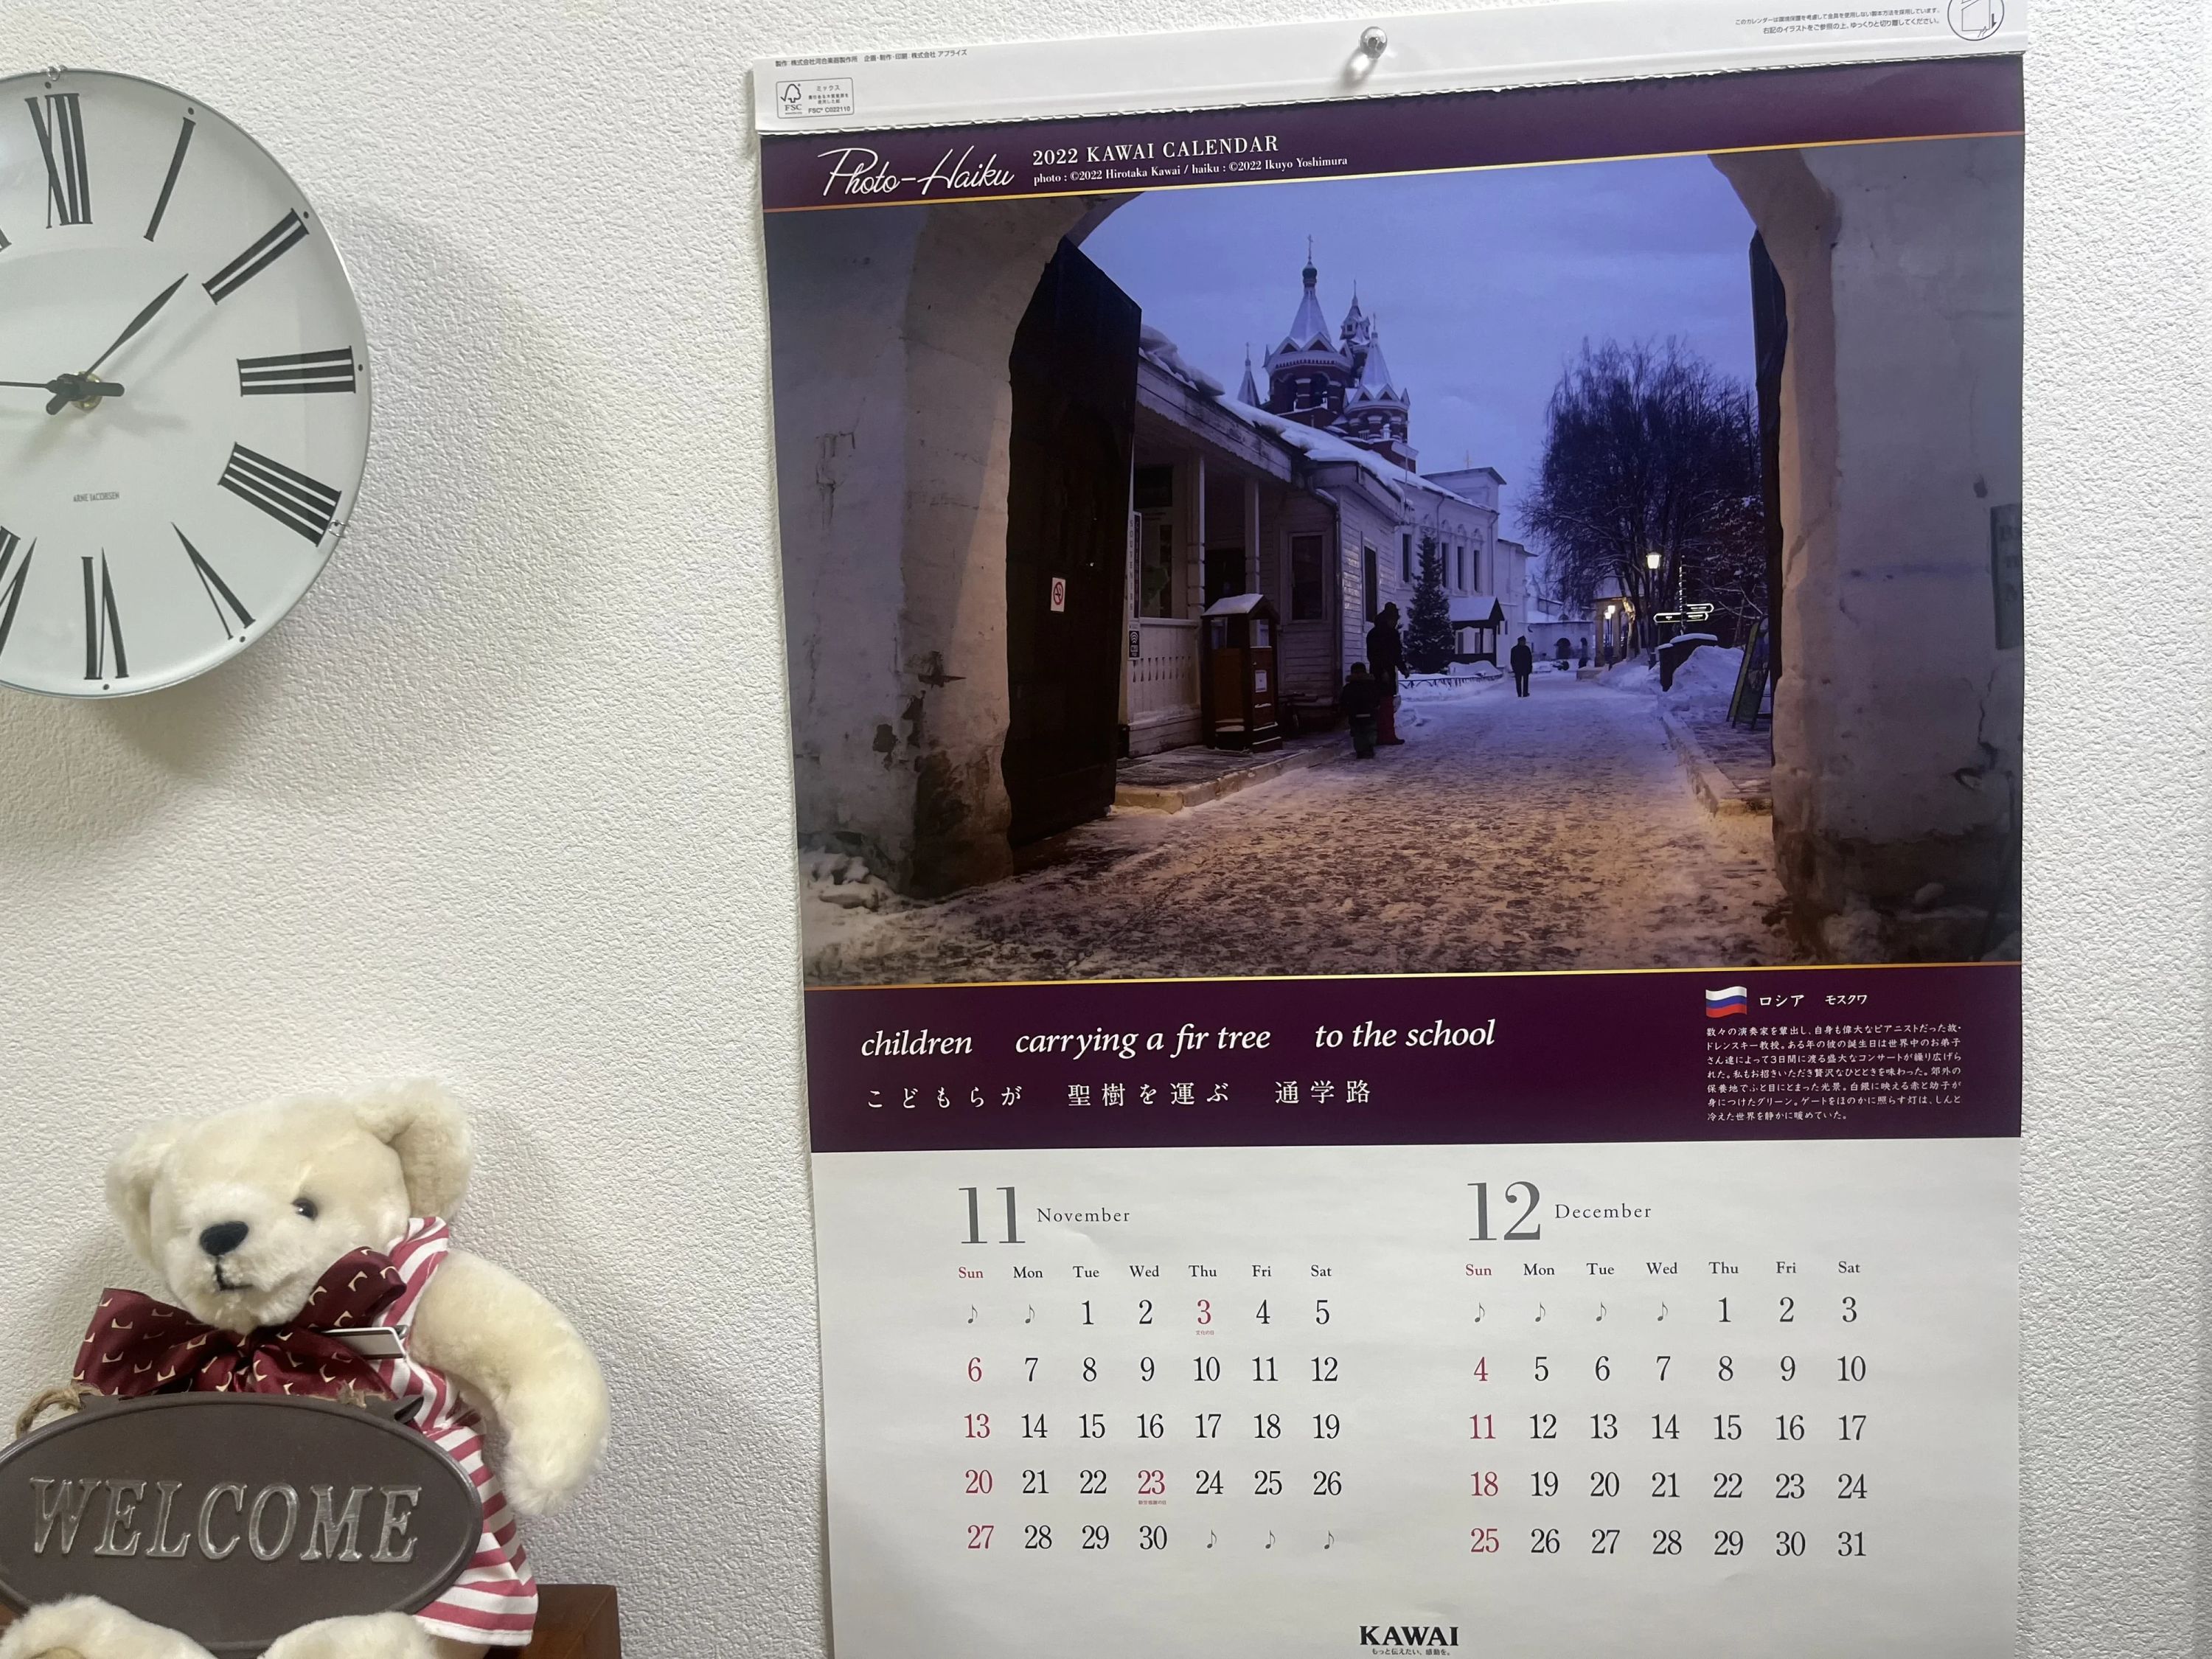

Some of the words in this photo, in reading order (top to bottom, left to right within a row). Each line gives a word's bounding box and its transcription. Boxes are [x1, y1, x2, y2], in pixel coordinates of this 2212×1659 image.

[26, 92, 94, 229] XII
[1032, 147, 1078, 166] 2022
[1087, 143, 1155, 162] KAWAI
[1163, 134, 1279, 158] CALENDAR
[1034, 173, 1062, 187] photo
[1071, 170, 1102, 181] ©2022
[1105, 167, 1149, 180] Hirotaka
[1151, 166, 1180, 176] Kawai
[1192, 163, 1220, 174] haiku
[1230, 160, 1262, 172] ©2022
[1265, 159, 1293, 170] Ikuyo
[1296, 155, 1348, 168] Yoshimura
[201, 207, 309, 305] II
[237, 346, 356, 396] III
[218, 442, 342, 547] IIII
[1759, 994, 1804, 1007] ロシア
[1825, 995, 1868, 1005] モスクワ
[861, 1029, 973, 1057] children
[1015, 1027, 1139, 1060] carrying
[1146, 1032, 1164, 1051] a
[1169, 1023, 1210, 1059] fir
[1217, 1026, 1271, 1049] tree
[1315, 1025, 1343, 1048] to
[1352, 1020, 1397, 1047] the
[1405, 1018, 1495, 1047] school
[868, 1085, 1022, 1109] こどもらが
[1068, 1082, 1228, 1107] 聖樹を運ぶ
[1275, 1079, 1371, 1104] 通学路
[958, 1186, 1026, 1244] 11
[1037, 1207, 1130, 1222] November
[1467, 1180, 1541, 1241] 12
[1555, 1203, 1652, 1220] December
[959, 1267, 984, 1279] Sun
[1013, 1266, 1043, 1279] Mon
[1072, 1265, 1099, 1278] Tue
[1129, 1265, 1159, 1278] Wed
[1188, 1265, 1217, 1277] Thu
[1251, 1265, 1271, 1277] Fri
[1311, 1265, 1332, 1277] Sat
[1465, 1264, 1492, 1276] Sun
[1523, 1263, 1555, 1276] Mon
[1586, 1262, 1615, 1275] Tue
[1646, 1262, 1677, 1275] Wed
[1708, 1262, 1739, 1274] Thu
[1776, 1261, 1796, 1274] Fri
[1838, 1261, 1860, 1273] Sat
[1082, 1300, 1094, 1325] 1
[1138, 1299, 1152, 1324] 2
[1197, 1299, 1211, 1325] 3
[1256, 1299, 1270, 1324] 4
[1315, 1299, 1330, 1325] 5
[1719, 1297, 1731, 1323] 1
[1779, 1296, 1794, 1323] 2
[1842, 1296, 1857, 1323] 3
[968, 1357, 982, 1382] 6
[1025, 1357, 1038, 1382] 7
[1082, 1357, 1097, 1382] 8
[1140, 1357, 1155, 1382] 9
[1193, 1356, 1220, 1382] 10
[1252, 1356, 1279, 1382] 11
[1311, 1357, 1338, 1382] 12
[1473, 1356, 1489, 1382] 4
[1534, 1356, 1549, 1382] 5
[1595, 1355, 1610, 1381] 6
[1656, 1355, 1671, 1381] 7
[1718, 1355, 1733, 1382] 8
[1780, 1355, 1795, 1382] 9
[1837, 1355, 1866, 1382] 10
[964, 1413, 990, 1439] 13
[1021, 1413, 1048, 1439] 14
[1079, 1413, 1105, 1439] 15
[1137, 1413, 1164, 1439] 16
[1195, 1413, 1222, 1439] 17
[1253, 1413, 1281, 1439] 18
[1312, 1413, 1340, 1439] 19
[1470, 1414, 1496, 1439] 11
[1529, 1413, 1557, 1439] 12
[1590, 1413, 1618, 1439] 13
[1652, 1413, 1680, 1439] 14
[1714, 1414, 1742, 1441] 15
[1775, 1414, 1805, 1441] 16
[1838, 1415, 1867, 1441] 17
[965, 1470, 992, 1494] 20
[1022, 1470, 1049, 1494] 21
[1079, 1470, 1107, 1494] 22
[1138, 1470, 1166, 1495] 23
[1196, 1470, 1224, 1495] 24
[1254, 1470, 1282, 1495] 25
[1313, 1470, 1342, 1496] 26
[1470, 1471, 1498, 1497] 18
[1531, 1471, 1559, 1497] 19
[1590, 1471, 1620, 1498] 20
[1652, 1472, 1680, 1498] 21
[1713, 1472, 1742, 1498] 22
[1775, 1473, 1805, 1499] 23
[1837, 1473, 1868, 1499] 24
[29, 1477, 422, 1563] WELCOME
[967, 1525, 995, 1549] 27
[1024, 1525, 1052, 1549] 28
[1082, 1525, 1110, 1550] 29
[1139, 1525, 1167, 1550] 30
[1470, 1528, 1500, 1554] 25
[1531, 1528, 1560, 1554] 26
[1591, 1528, 1621, 1554] 27
[1652, 1529, 1682, 1555] 28
[1714, 1530, 1744, 1556] 29
[1775, 1531, 1806, 1557] 30
[1837, 1531, 1866, 1557] 31
[1360, 1625, 1458, 1646] KAWAI
